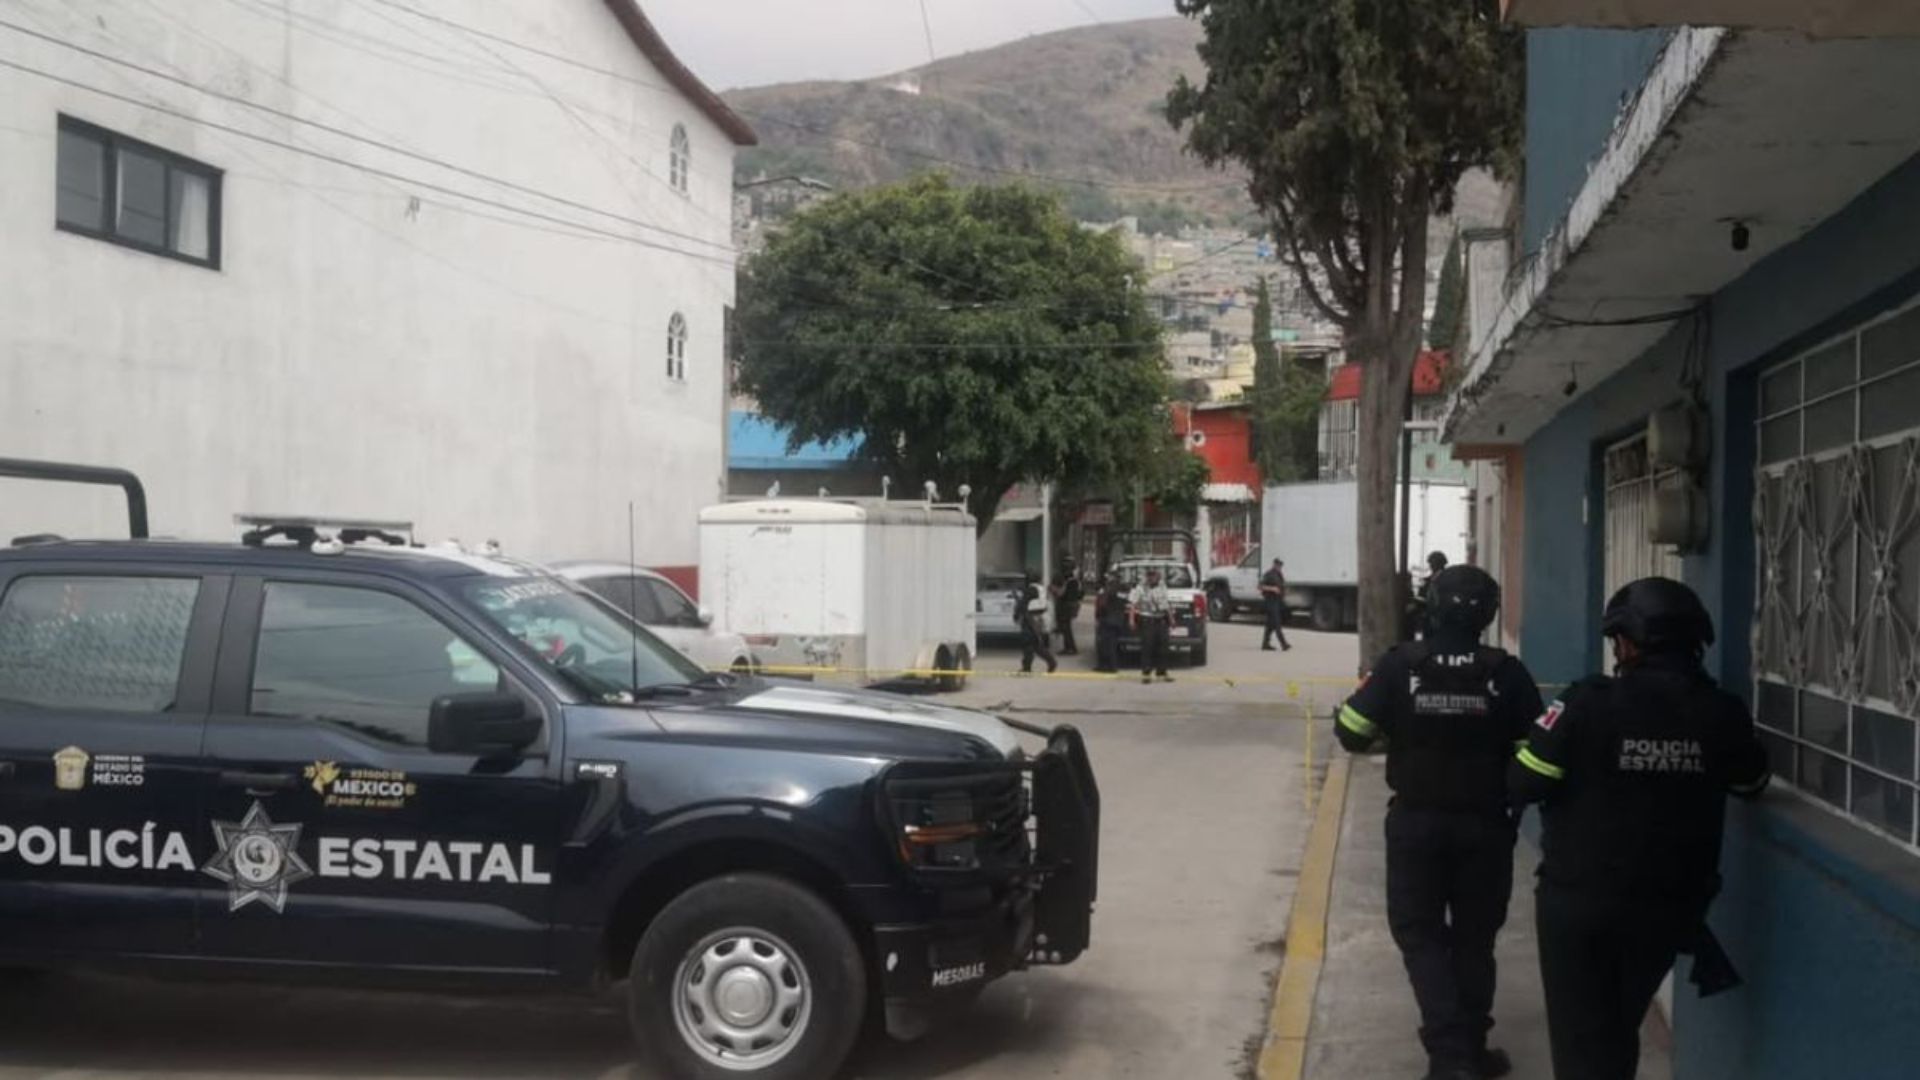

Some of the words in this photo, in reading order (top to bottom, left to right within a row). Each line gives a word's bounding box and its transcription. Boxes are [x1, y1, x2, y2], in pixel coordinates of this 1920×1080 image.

[94, 762, 129, 771] ESTADO
[131, 763, 144, 772] DE
[1619, 754, 1705, 773] ESTATAL
[93, 771, 144, 786] MÉXICO
[318, 837, 551, 884] ESTATAL
